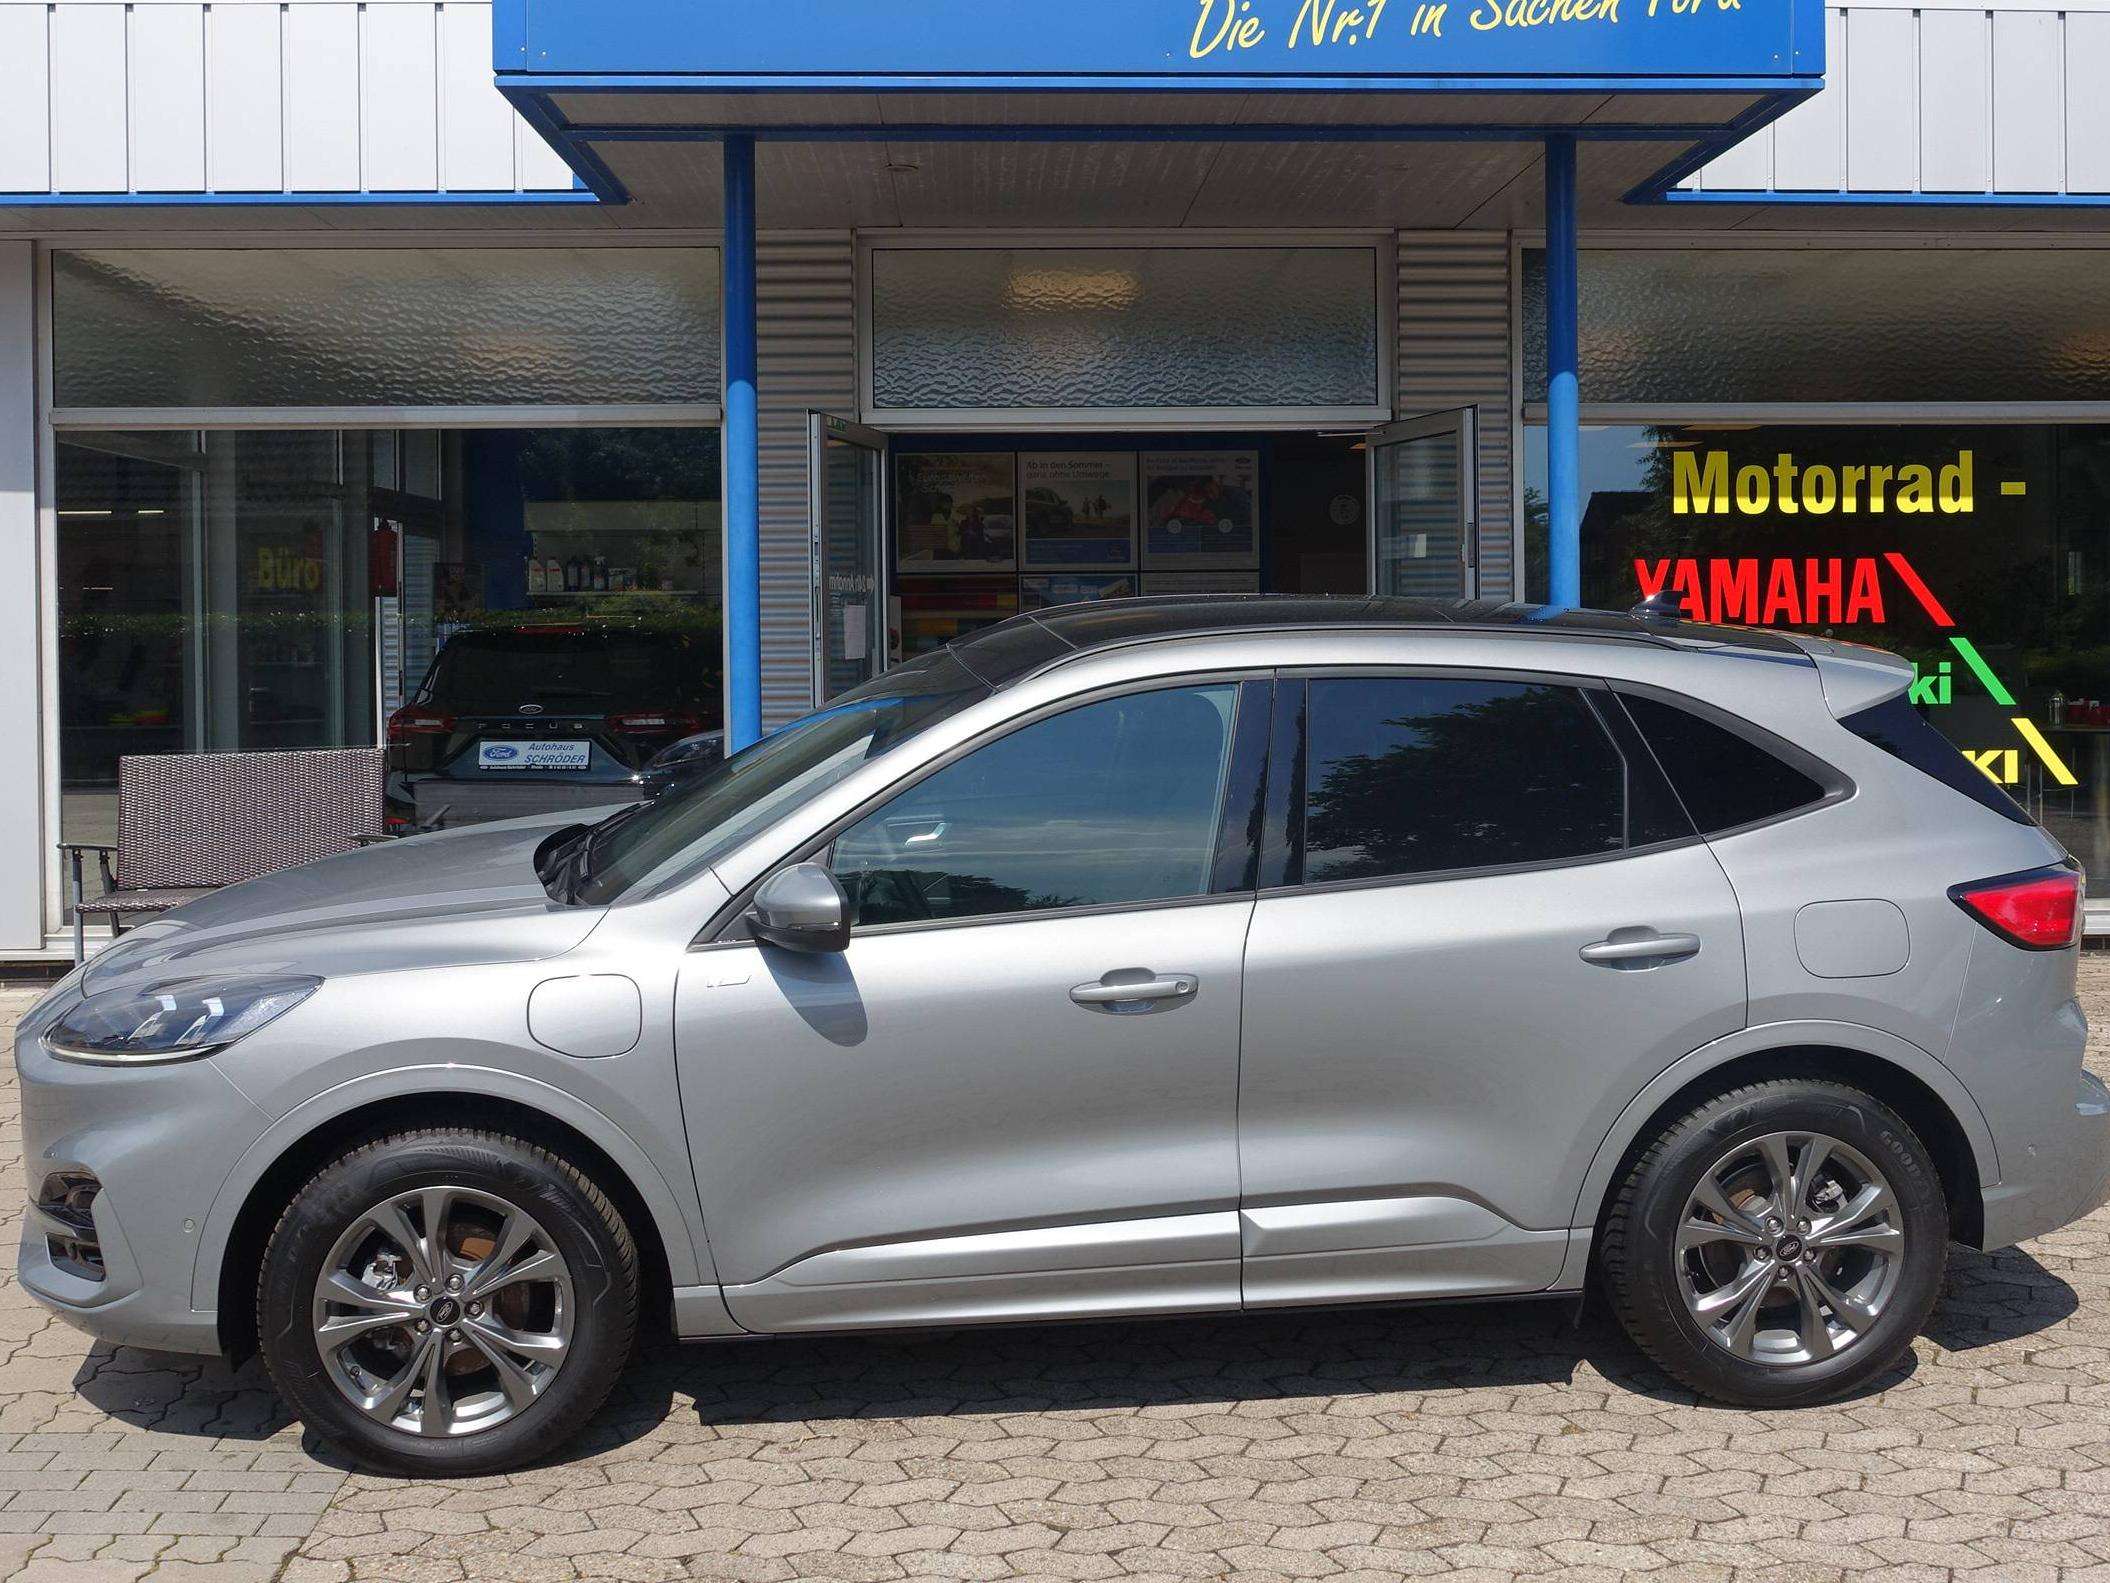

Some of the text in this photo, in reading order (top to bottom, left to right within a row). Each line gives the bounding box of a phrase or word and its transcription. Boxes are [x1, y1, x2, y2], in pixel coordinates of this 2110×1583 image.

[1190, 0, 1265, 58] Die
[1411, 4, 1447, 37] in
[1673, 451, 1973, 514] Motorrad
[256, 546, 320, 589] Büro
[1634, 558, 1885, 623] YAMAHA
[525, 751, 586, 764] SCHRÖDER
[528, 742, 576, 751] Autohaus
